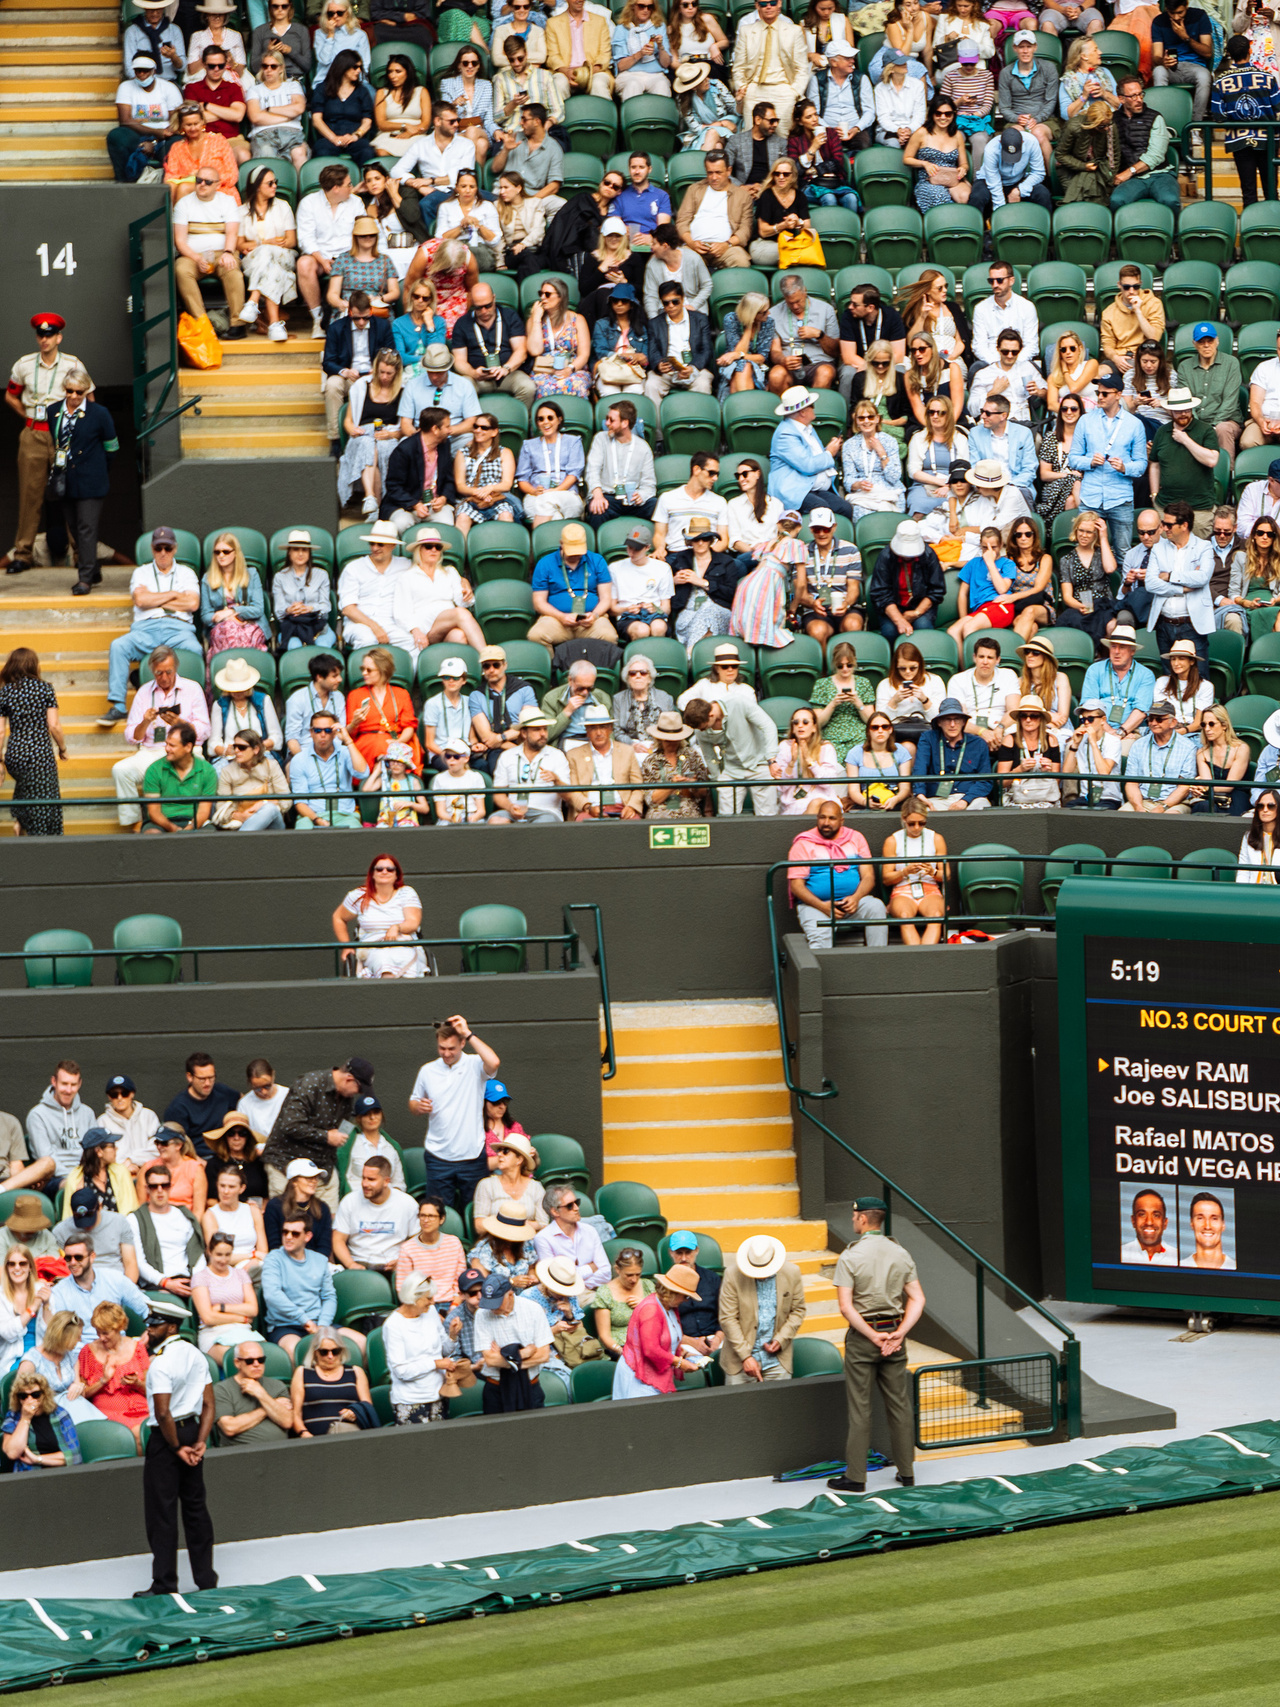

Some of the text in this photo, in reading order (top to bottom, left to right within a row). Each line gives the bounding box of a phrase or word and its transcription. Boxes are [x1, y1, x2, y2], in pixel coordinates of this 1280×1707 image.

[35, 242, 78, 277] 14
[690, 828, 707, 836] Fire
[690, 836, 707, 844] exit
[1110, 958, 1161, 983] 5:19
[1140, 1009, 1189, 1030] NO.3
[1193, 1012, 1268, 1034] COURT
[1113, 1056, 1249, 1084] Rajeev RAM
[1113, 1084, 1156, 1106] Joe
[1114, 1124, 1275, 1154] Rafael MATOS
[1115, 1152, 1179, 1176] David
[1183, 1156, 1252, 1181] VEGA
